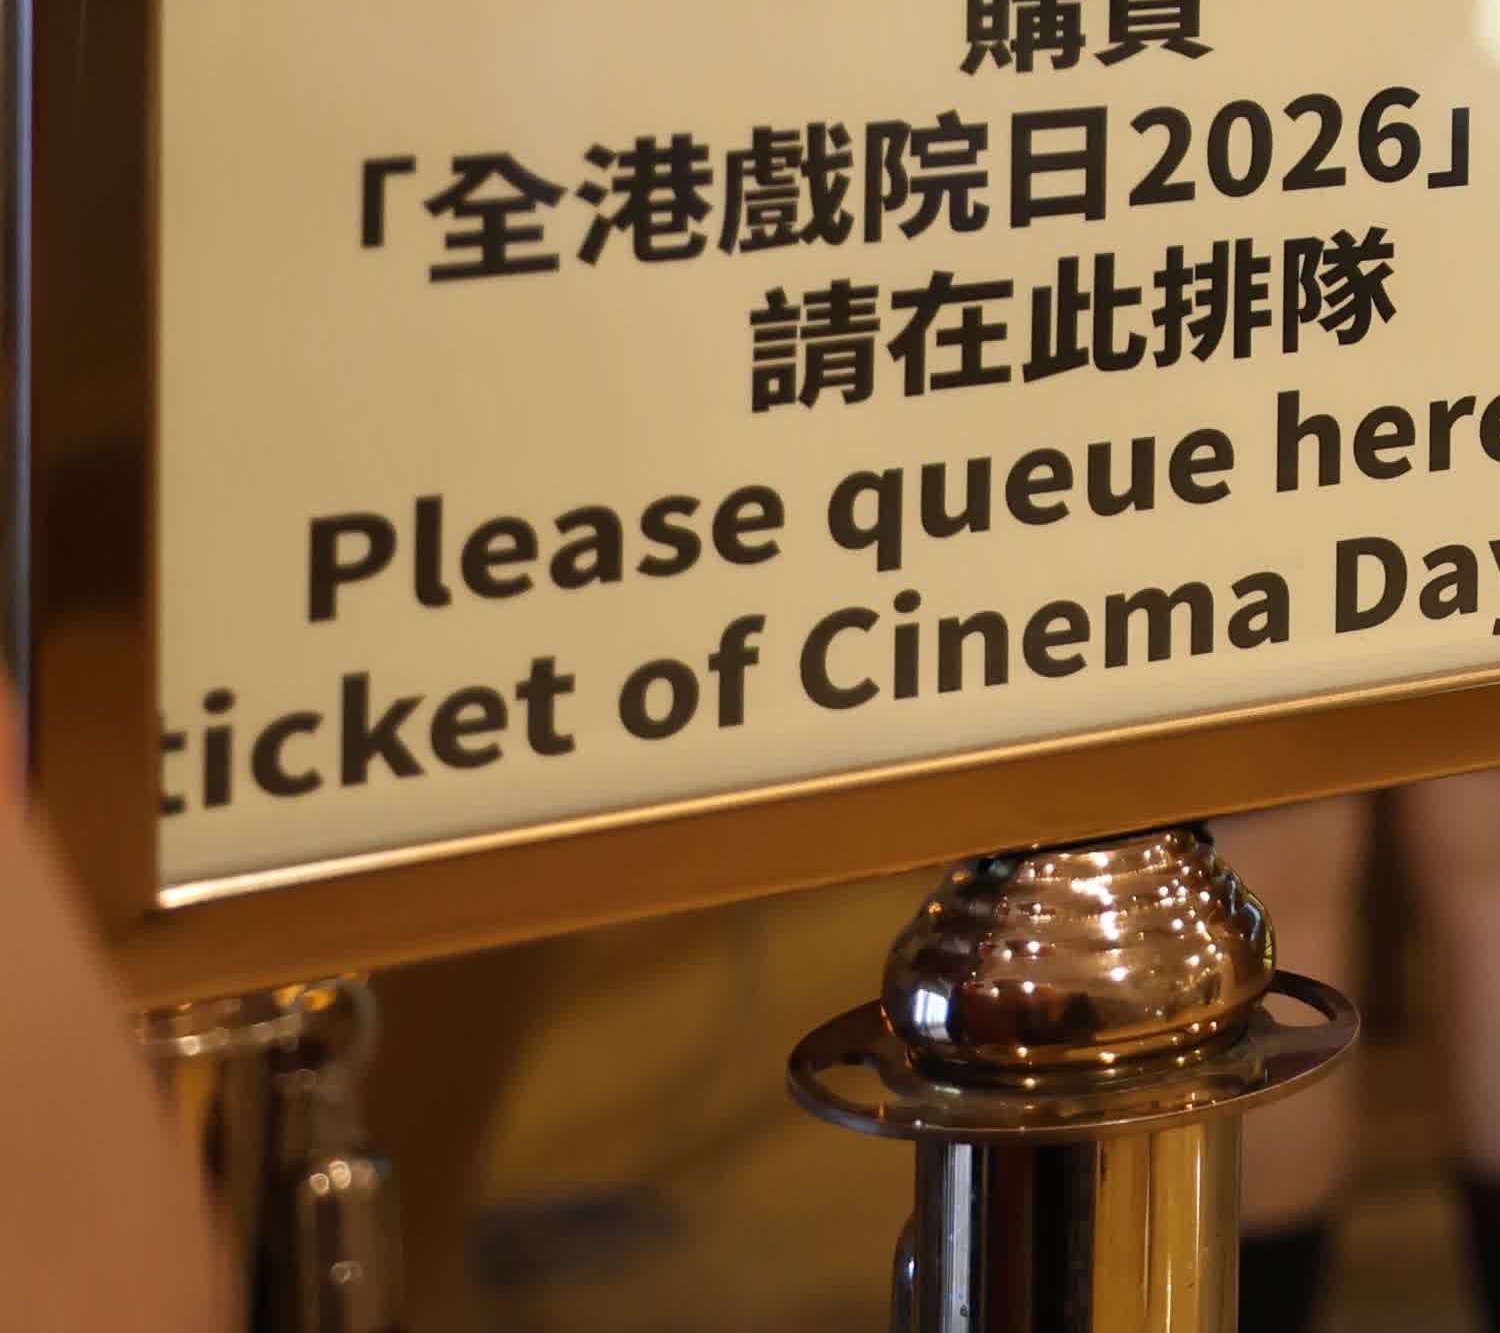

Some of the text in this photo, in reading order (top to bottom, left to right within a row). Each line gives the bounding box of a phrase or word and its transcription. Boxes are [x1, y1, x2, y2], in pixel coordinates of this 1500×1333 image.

[748, 225, 1398, 415] 請在此排隊
[306, 484, 786, 625] Please
[826, 427, 1236, 574] queue
[617, 613, 767, 742] of
[798, 570, 1291, 711] Cinema
